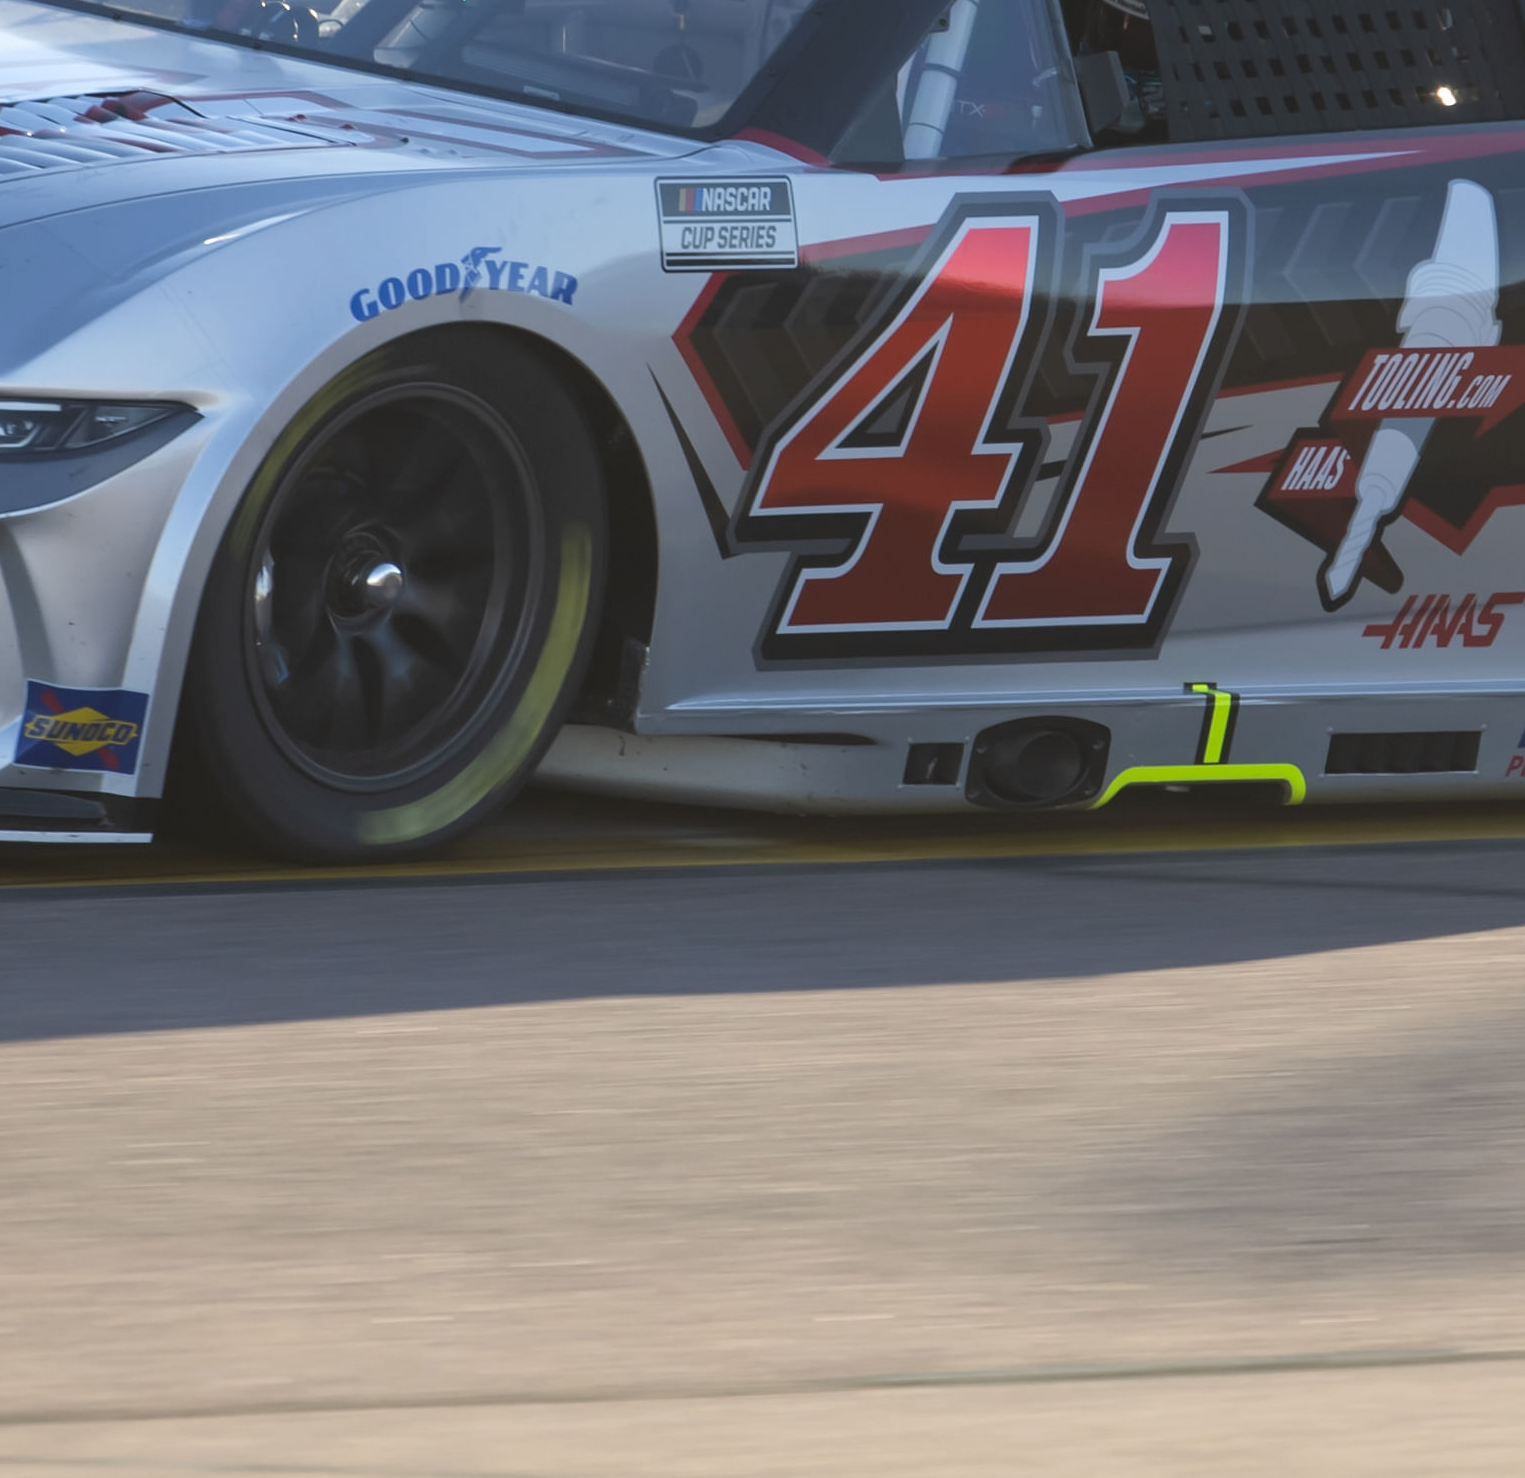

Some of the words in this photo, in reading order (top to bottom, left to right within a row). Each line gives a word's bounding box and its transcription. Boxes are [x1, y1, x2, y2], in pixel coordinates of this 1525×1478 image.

[701, 186, 772, 212] NASCAR
[681, 226, 715, 250] CUP
[717, 225, 777, 250] SERIES
[739, 200, 1243, 652] 41
[1280, 445, 1352, 491] HAAS
[27, 715, 136, 746] SUNOCO
